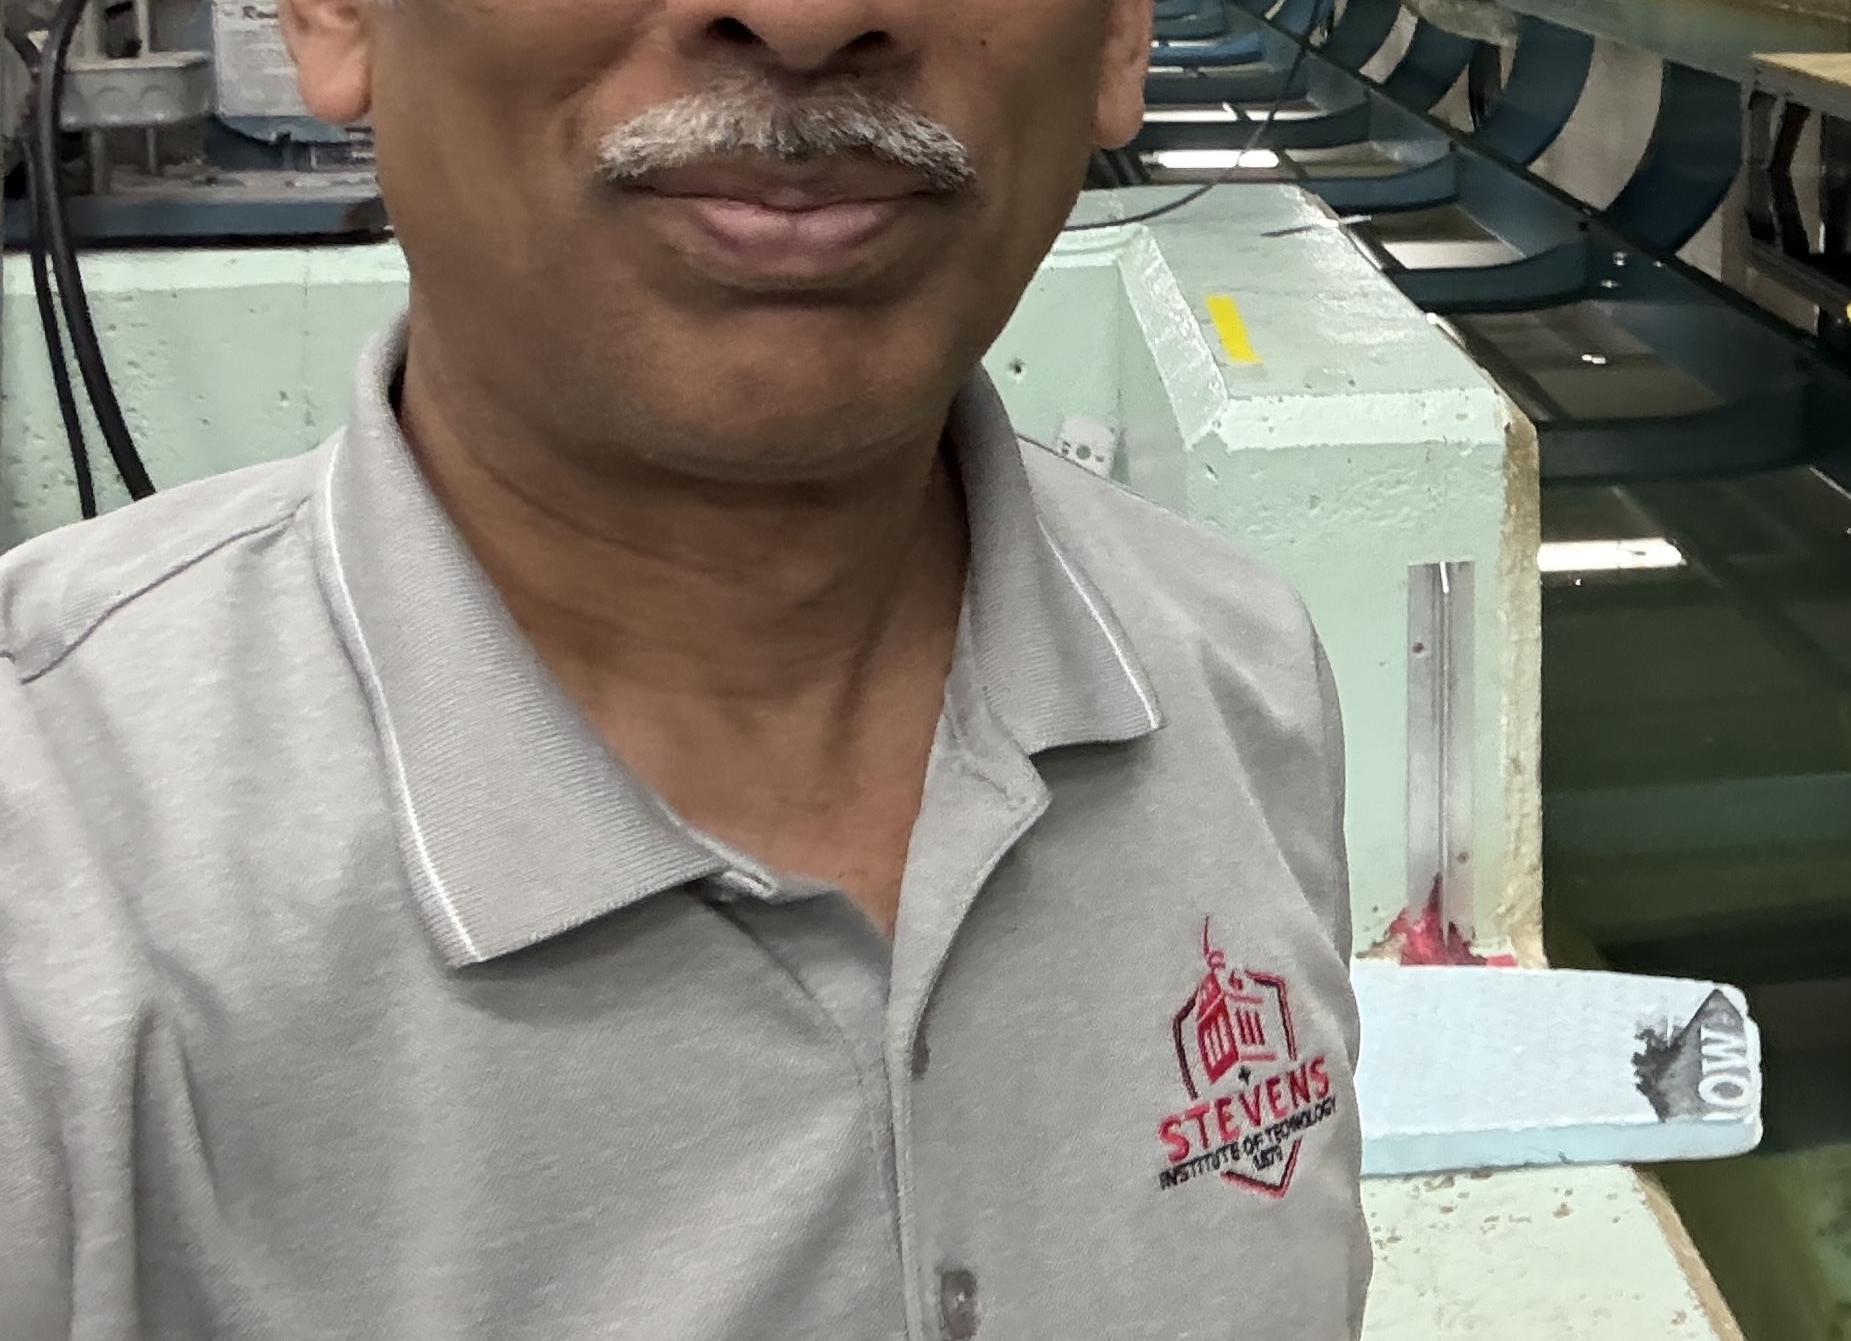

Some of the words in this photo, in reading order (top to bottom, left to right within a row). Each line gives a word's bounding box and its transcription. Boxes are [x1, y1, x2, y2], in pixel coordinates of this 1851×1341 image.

[1159, 1053, 1330, 1164] STEVENS
[1698, 1024, 1751, 1121] OW
[1159, 1141, 1241, 1190] INSTITUTE
[1242, 1132, 1264, 1156] OF
